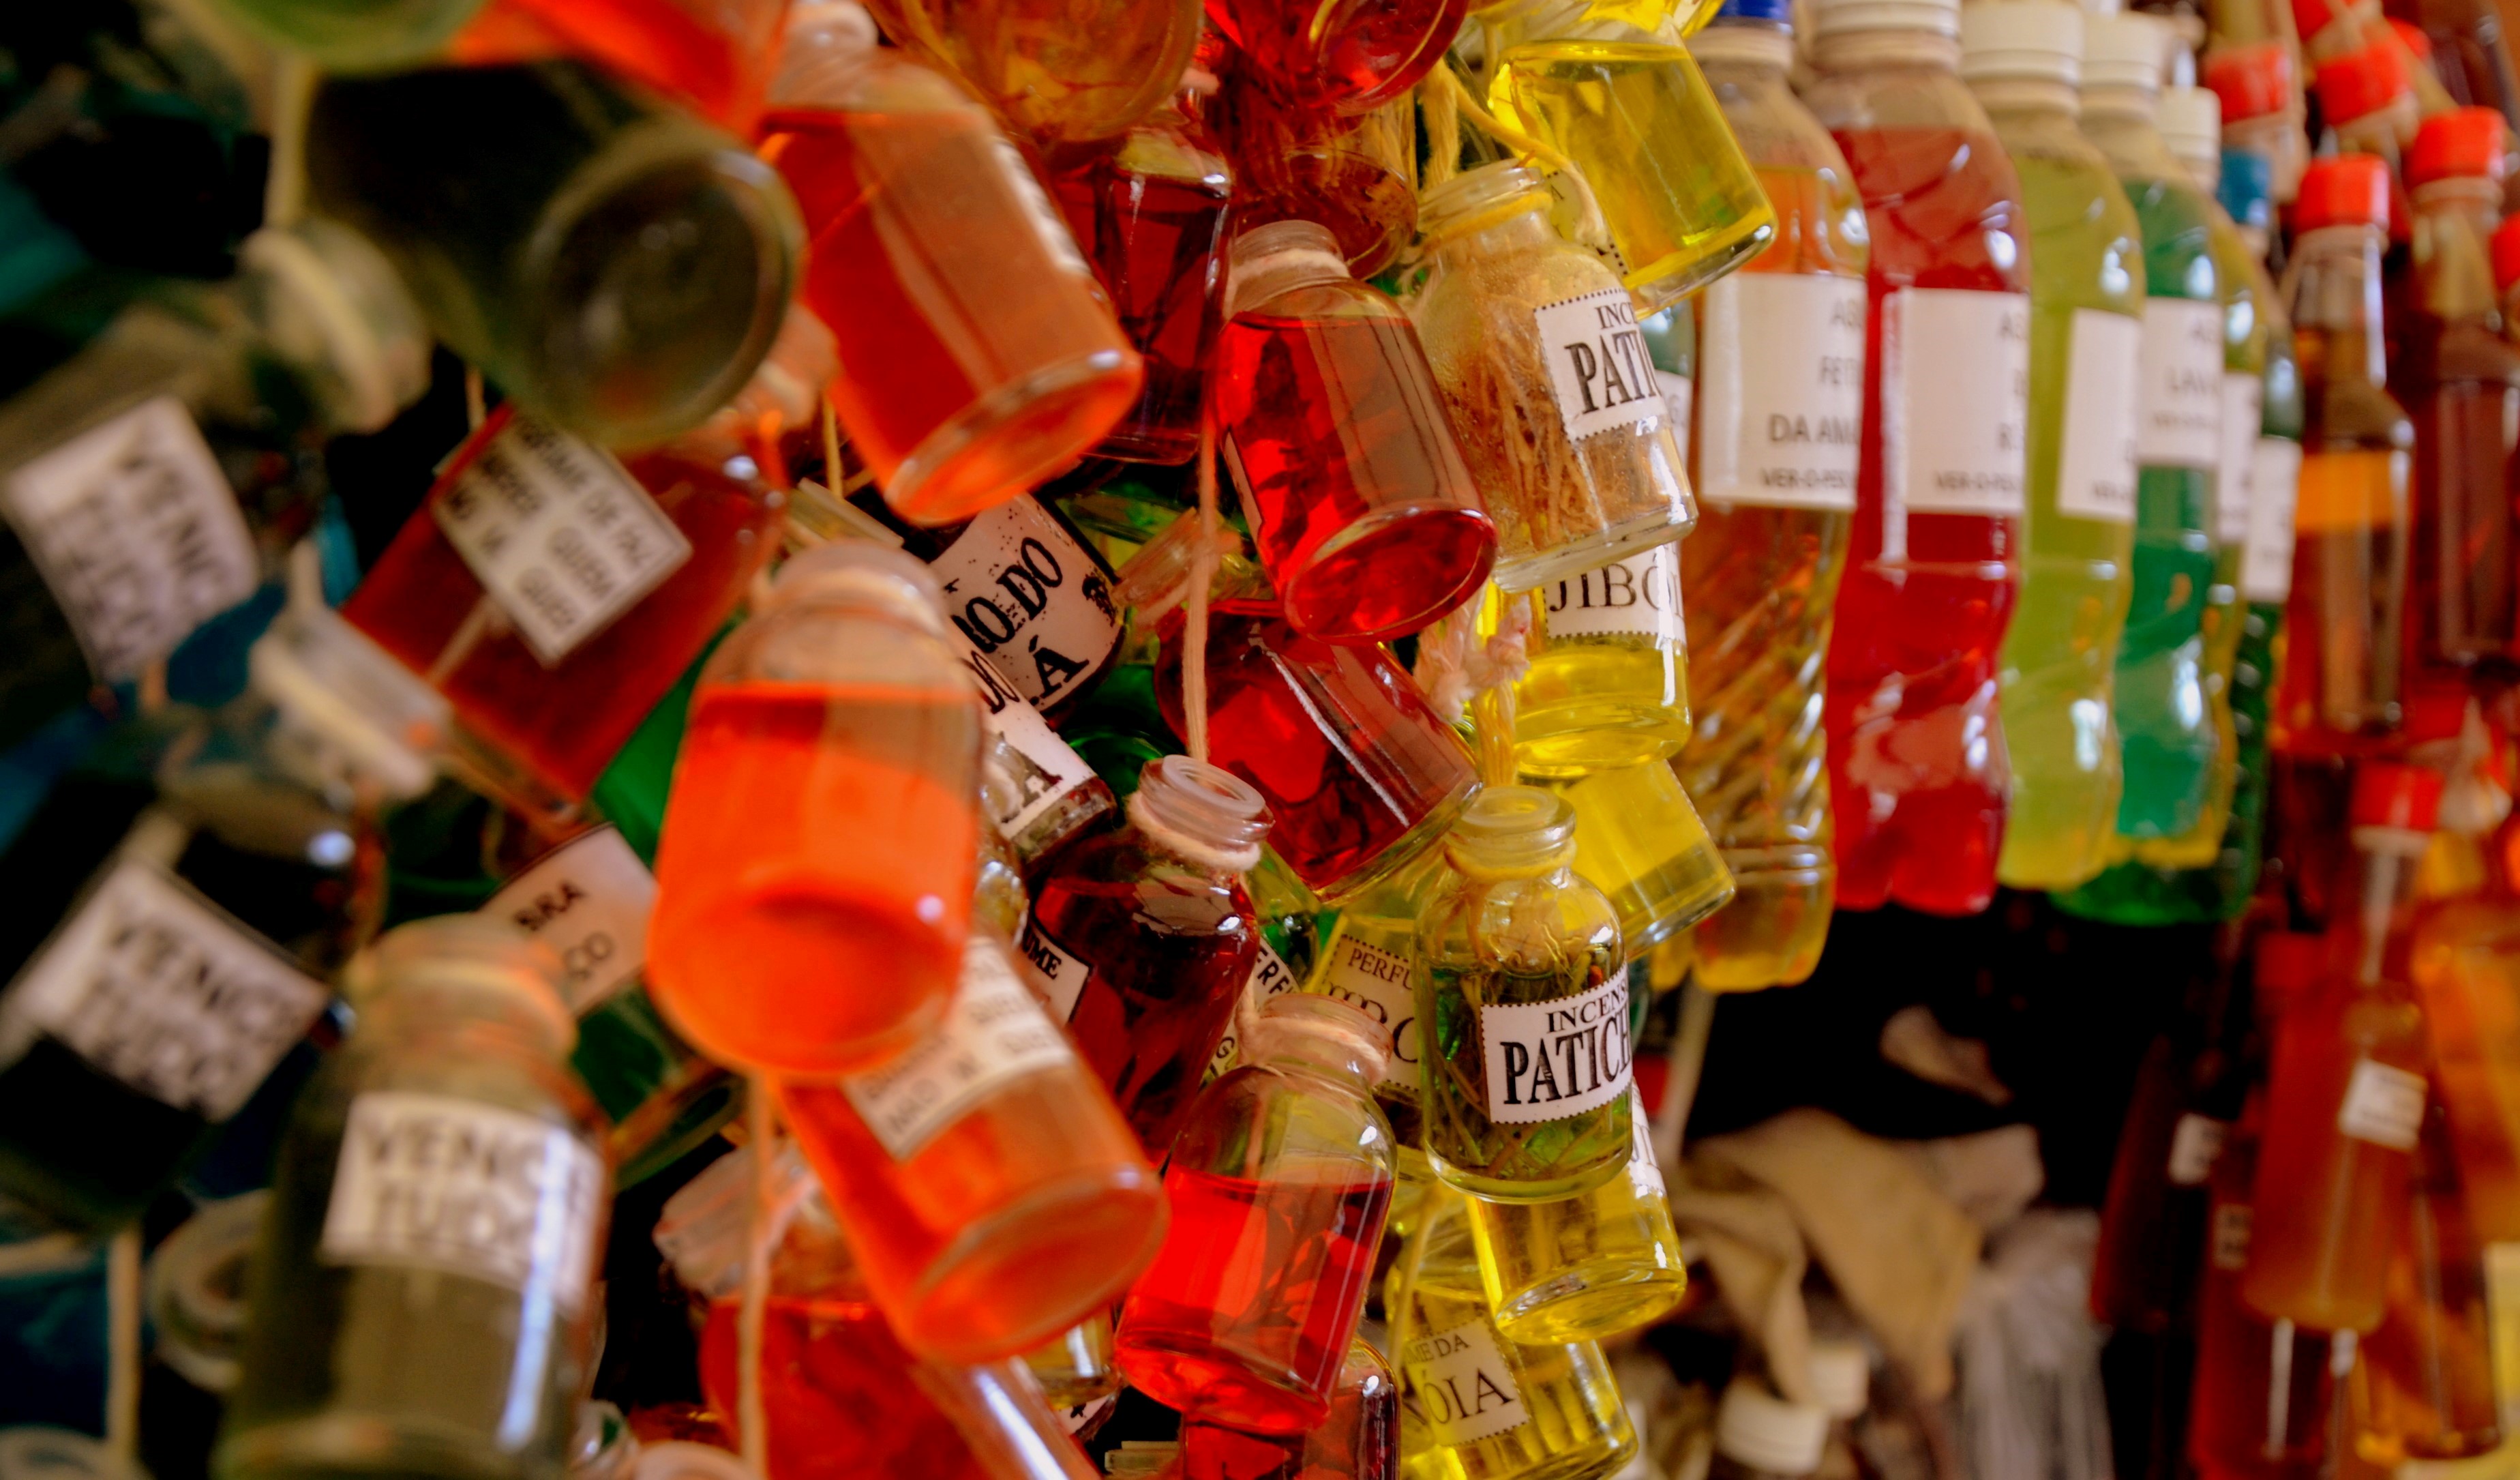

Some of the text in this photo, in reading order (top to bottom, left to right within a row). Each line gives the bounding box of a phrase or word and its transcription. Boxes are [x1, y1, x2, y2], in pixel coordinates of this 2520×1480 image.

[1564, 329, 1663, 415] PATI
[1028, 634, 1090, 706] Á
[1434, 1333, 1471, 1357] DA
